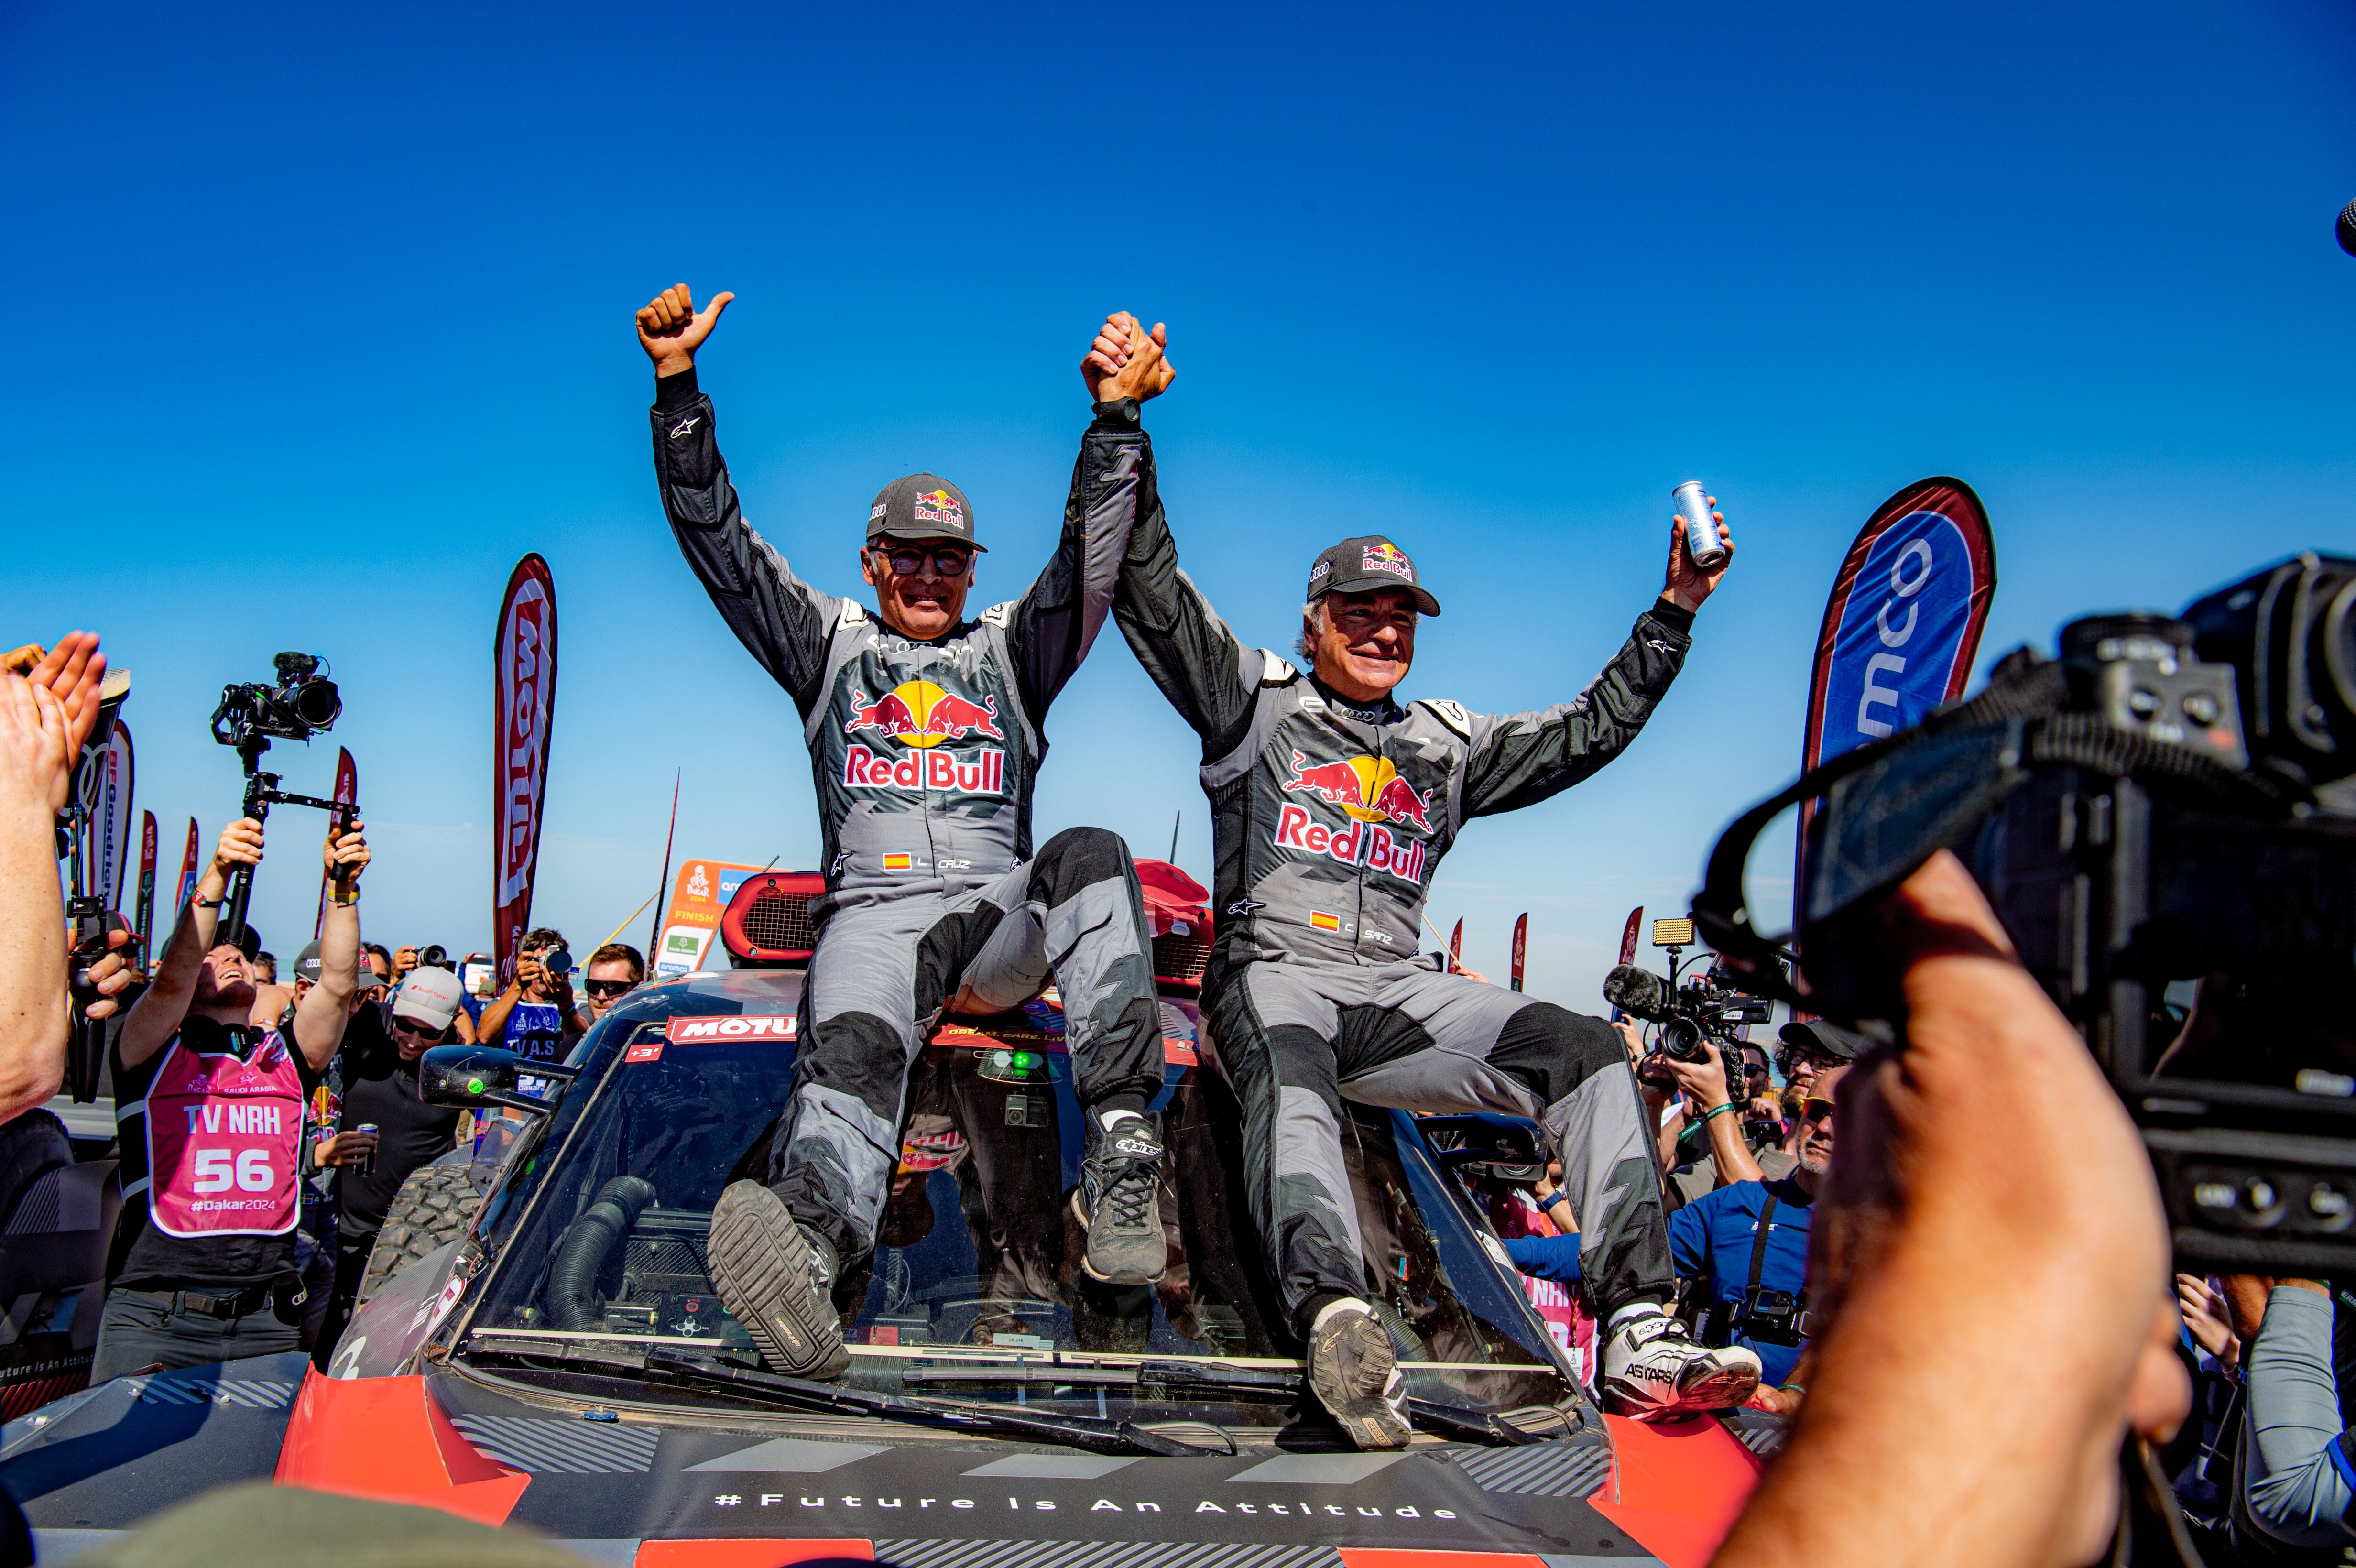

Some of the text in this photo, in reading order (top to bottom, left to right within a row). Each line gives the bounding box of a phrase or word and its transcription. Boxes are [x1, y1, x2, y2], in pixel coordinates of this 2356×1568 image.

[915, 506, 964, 529] Red Bull
[1363, 558, 1413, 582] Red Bull
[1855, 538, 1932, 751] mco
[511, 616, 537, 862] MOTUL
[843, 744, 1005, 795] Red Bull
[1274, 802, 1427, 884] Red Bull
[917, 857, 971, 869] L. CRUZ
[687, 884, 710, 897] DAKAR
[675, 910, 714, 923] FINISH
[1344, 923, 1393, 945] C. SAINZ
[433, 991, 450, 1002] Sport
[680, 1018, 797, 1037] MOTU
[507, 1039, 526, 1055] TV
[469, 1080, 481, 1090] SAFETY
[184, 1105, 222, 1134] TV
[228, 1105, 281, 1135] NRH
[1706, 1105, 1729, 1118] PERMANENT
[193, 1149, 274, 1193] 56
[190, 1199, 275, 1212] #Dakar2024
[34, 1361, 44, 1372] Is
[47, 1360, 59, 1370] An
[1625, 1363, 1673, 1384] ASTARS
[715, 1494, 1457, 1519] #Future Is An Attitude
